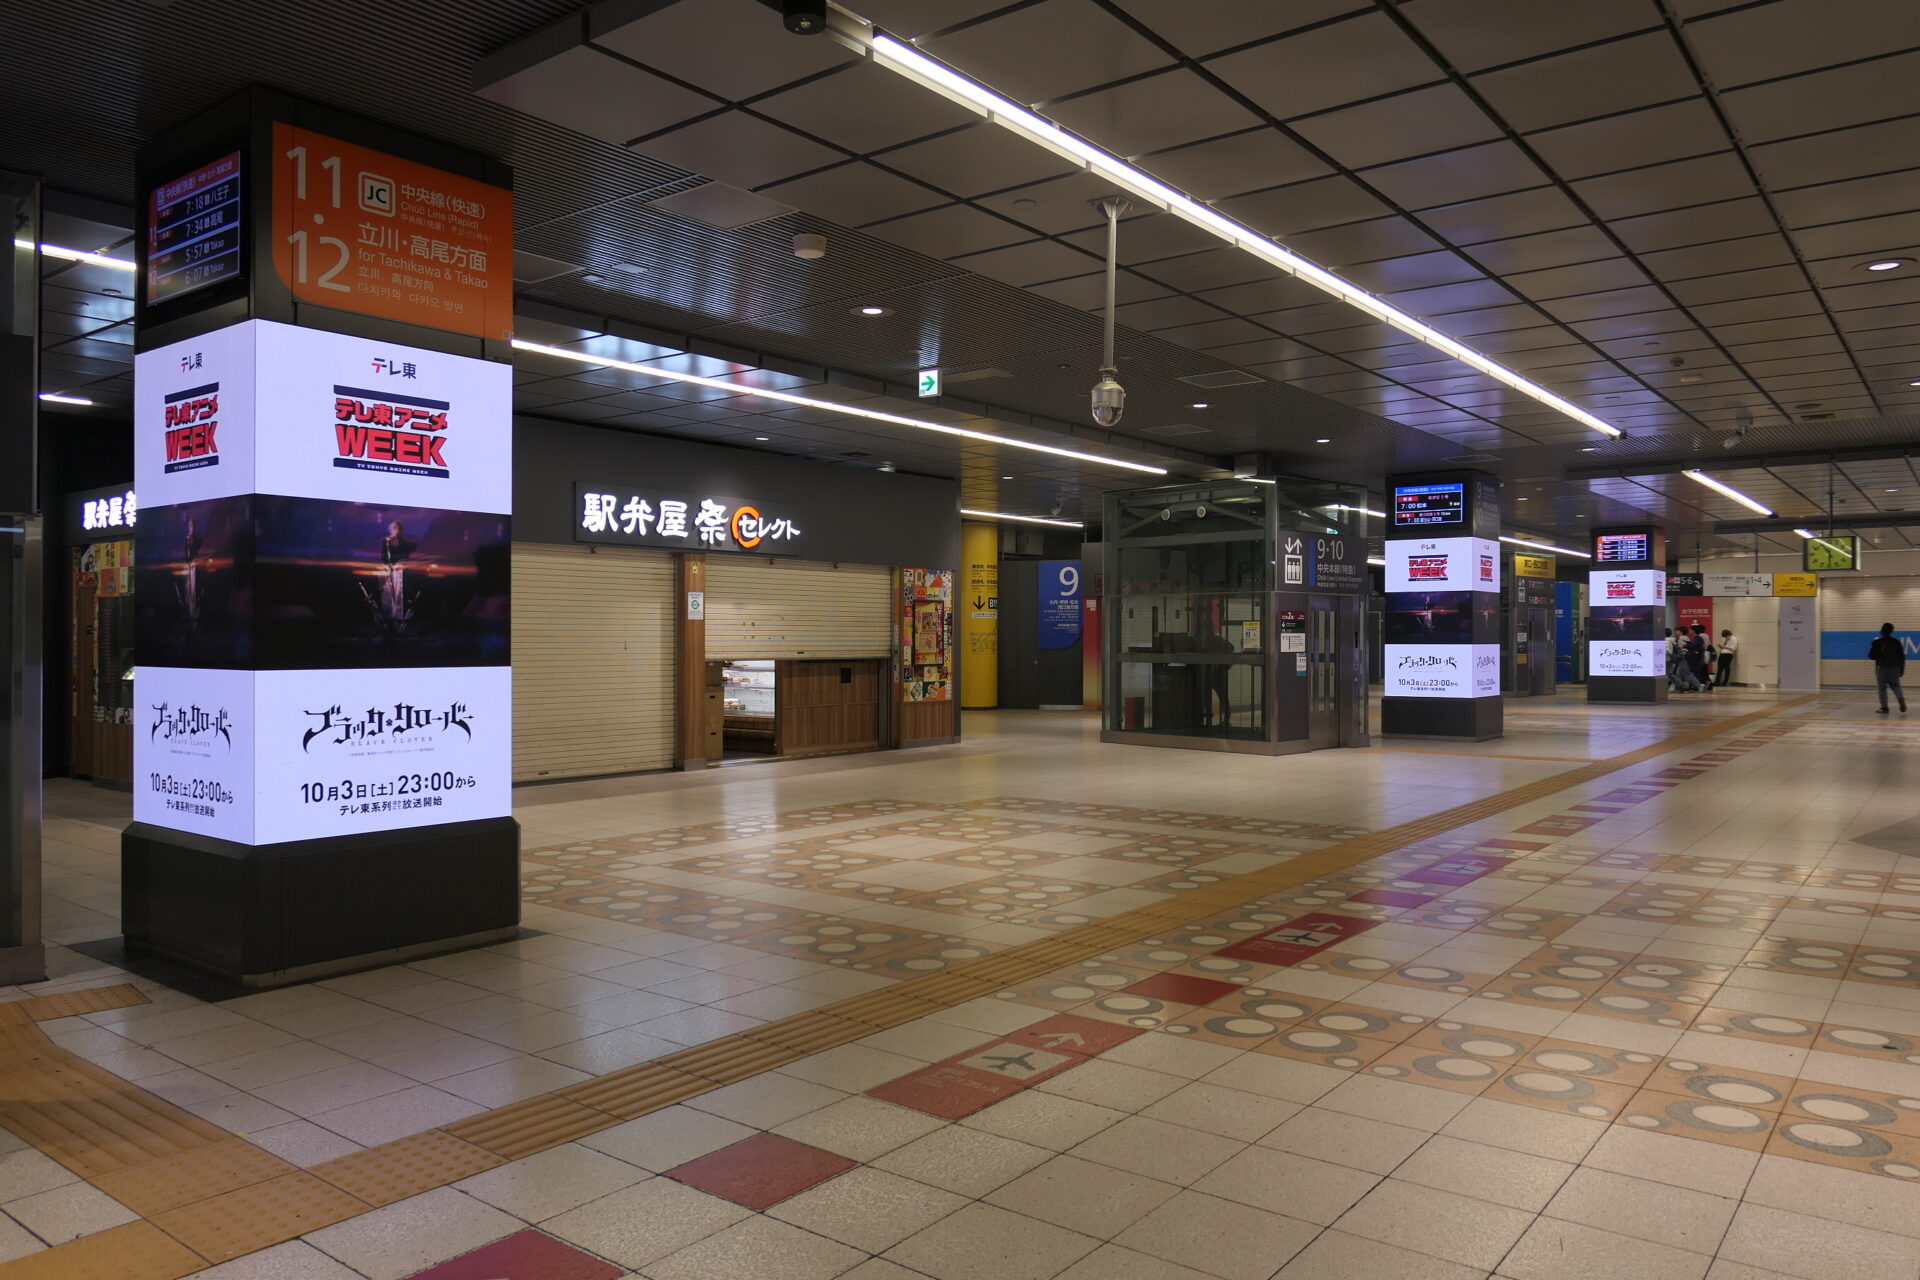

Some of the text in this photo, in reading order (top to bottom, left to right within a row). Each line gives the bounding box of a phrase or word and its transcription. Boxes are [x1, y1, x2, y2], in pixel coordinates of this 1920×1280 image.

[286, 146, 341, 209] 11
[367, 185, 387, 204] JC
[185, 218, 204, 238] 7:34
[427, 207, 447, 220] Line
[448, 214, 479, 230] (Rapid)
[185, 244, 203, 262] 5:57
[287, 230, 351, 294] 12
[358, 248, 488, 289] for Tachikawa & Takao
[181, 352, 203, 374] テレ東
[371, 357, 417, 379] テレ東
[165, 394, 219, 428] テレ東アニメ
[335, 397, 448, 432] テレ東アニメ
[165, 421, 218, 462] WEEK
[335, 423, 448, 467] WEEK
[1059, 566, 1079, 596] 9
[1408, 566, 1448, 578] WEEK
[192, 778, 234, 804] 23:00から
[398, 770, 477, 796] 23:00から
